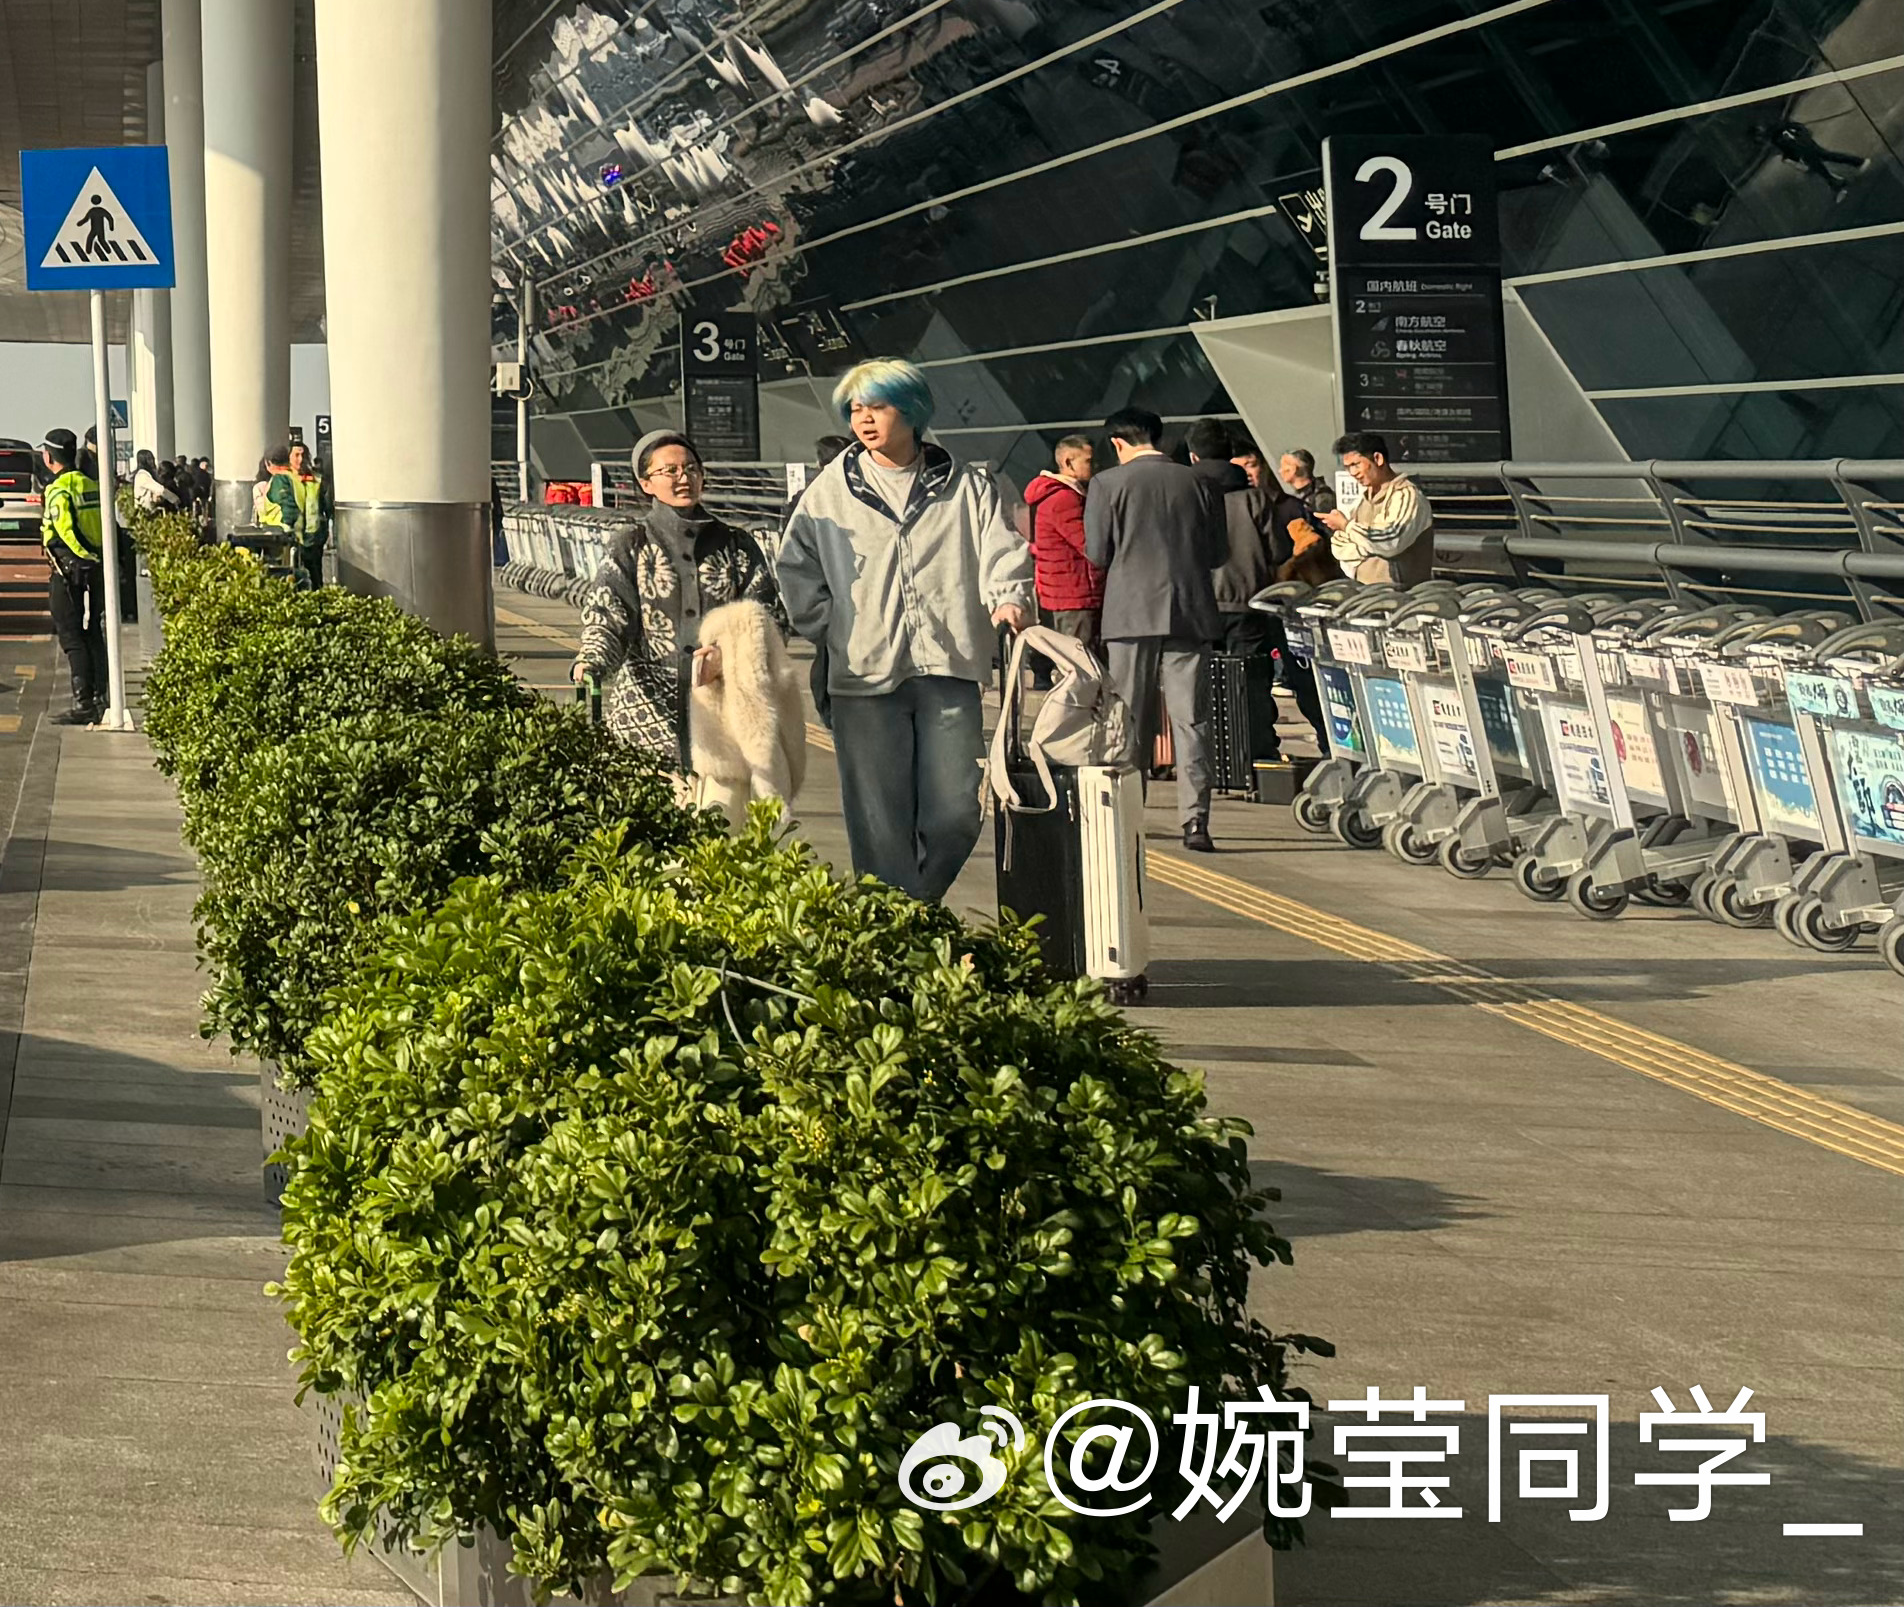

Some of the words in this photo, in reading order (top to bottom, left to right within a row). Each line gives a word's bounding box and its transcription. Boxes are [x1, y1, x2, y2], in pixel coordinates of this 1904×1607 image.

[1355, 156, 1417, 240] 2
[1424, 193, 1472, 215] 号门
[1425, 220, 1472, 239] Gate
[1355, 300, 1366, 313] 2
[693, 321, 720, 362] 3
[1360, 373, 1369, 387] 3
[1361, 407, 1371, 420] 4
[318, 418, 330, 434] 5
